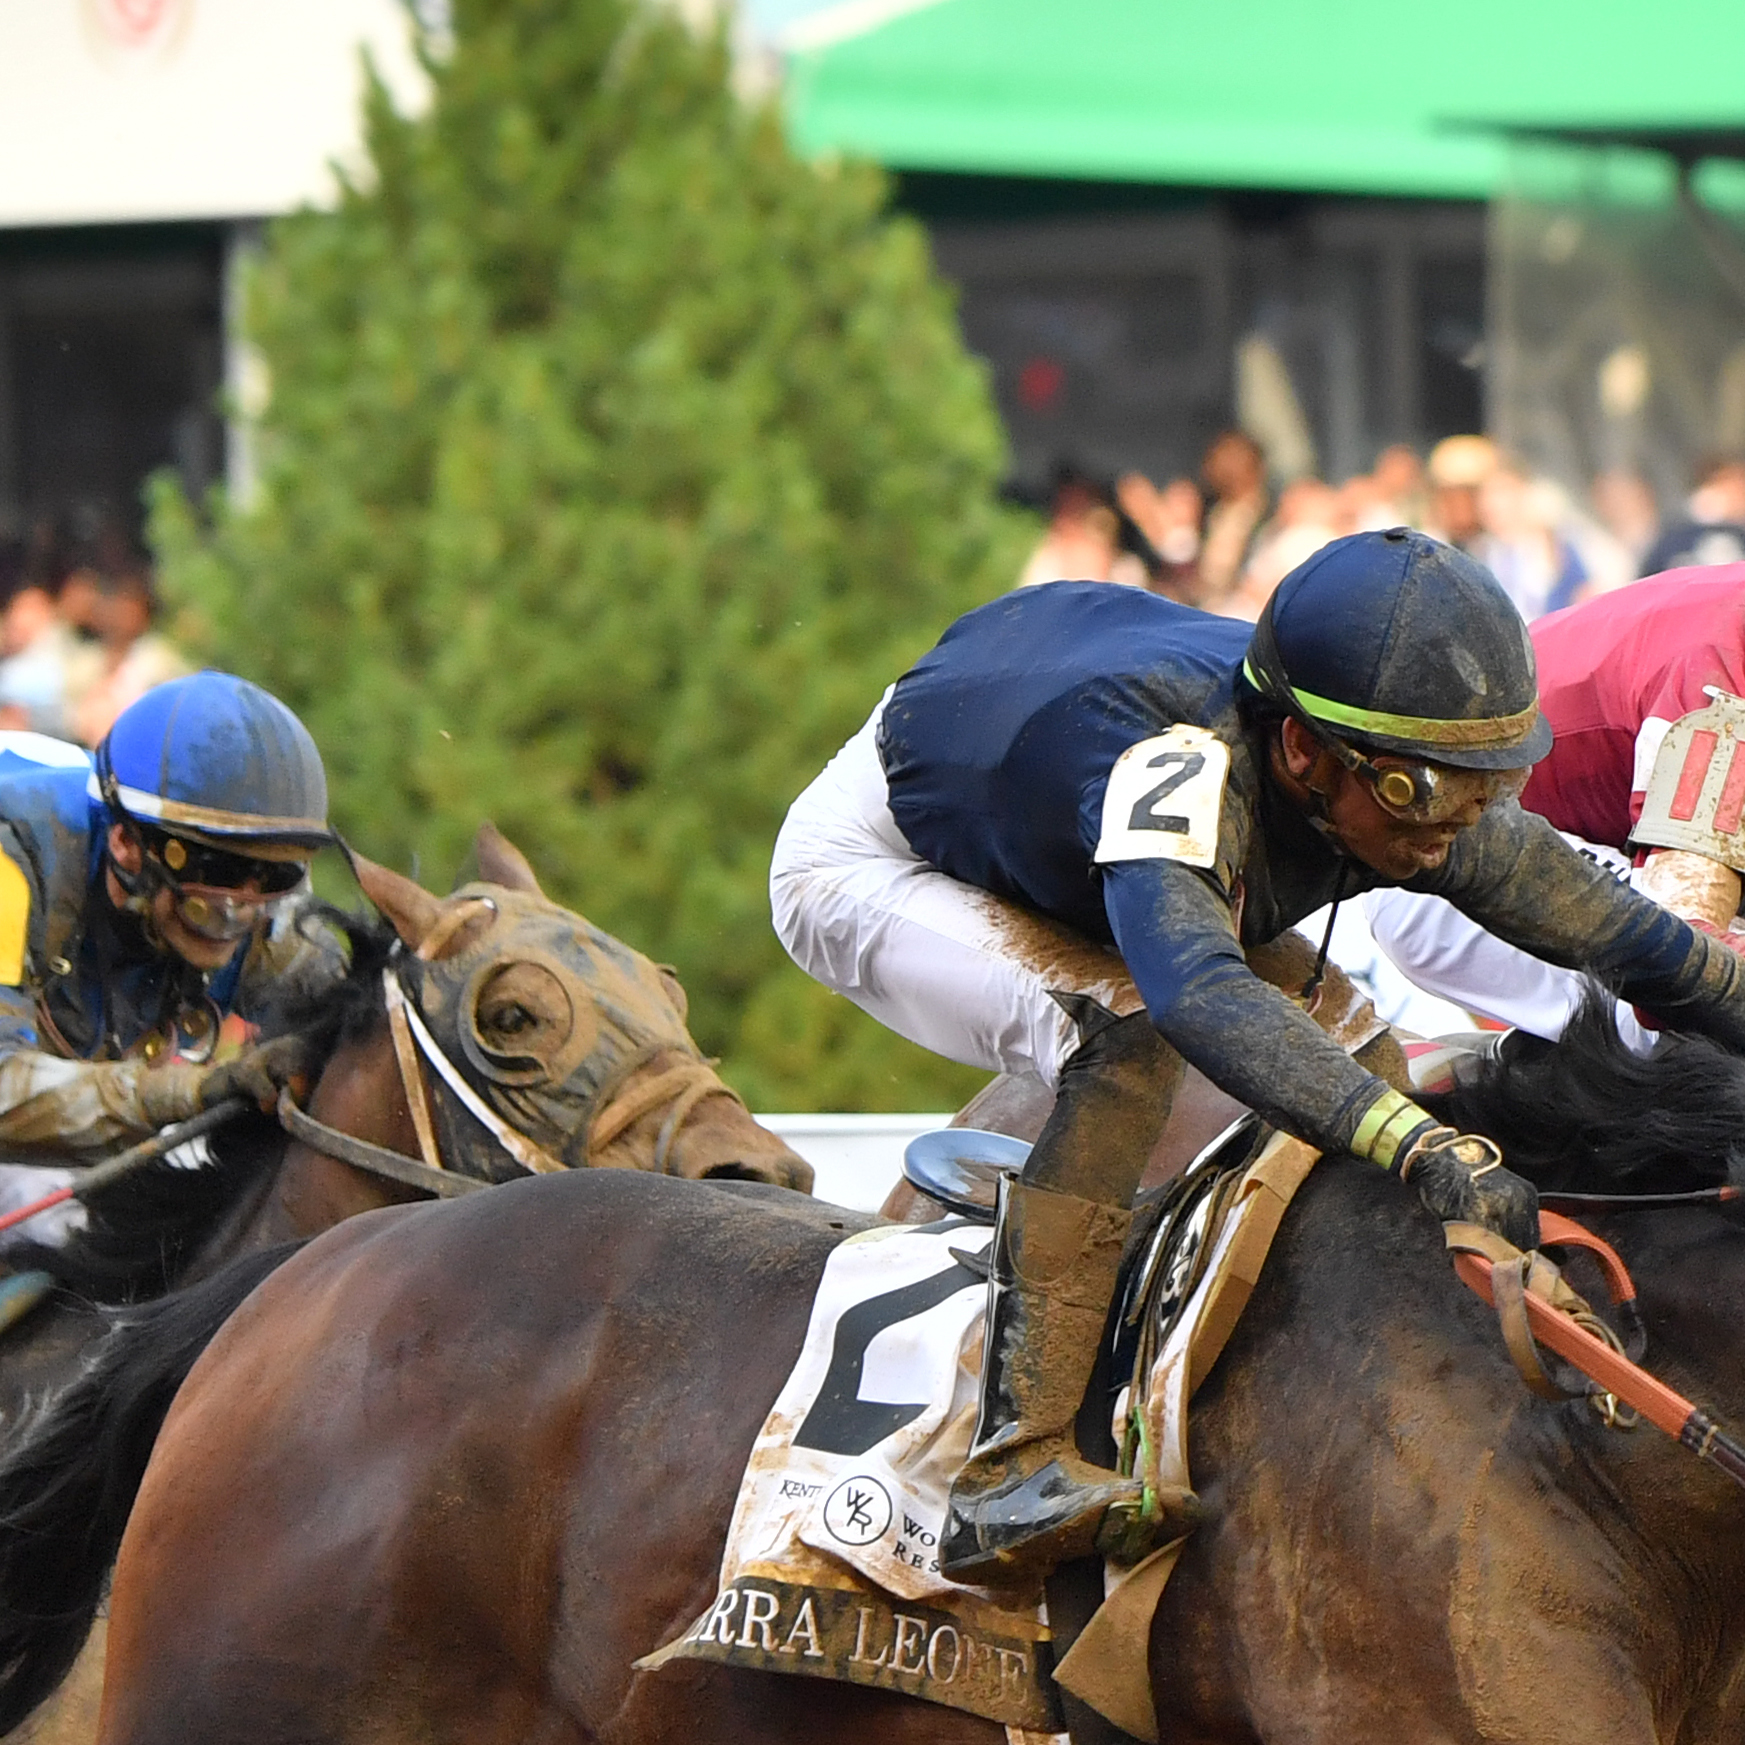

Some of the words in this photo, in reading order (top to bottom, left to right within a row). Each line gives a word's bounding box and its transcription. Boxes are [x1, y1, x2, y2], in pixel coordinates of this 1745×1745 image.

[1127, 751, 1206, 835] 2
[790, 1217, 997, 1457] 2
[779, 1479, 823, 1499] KENT
